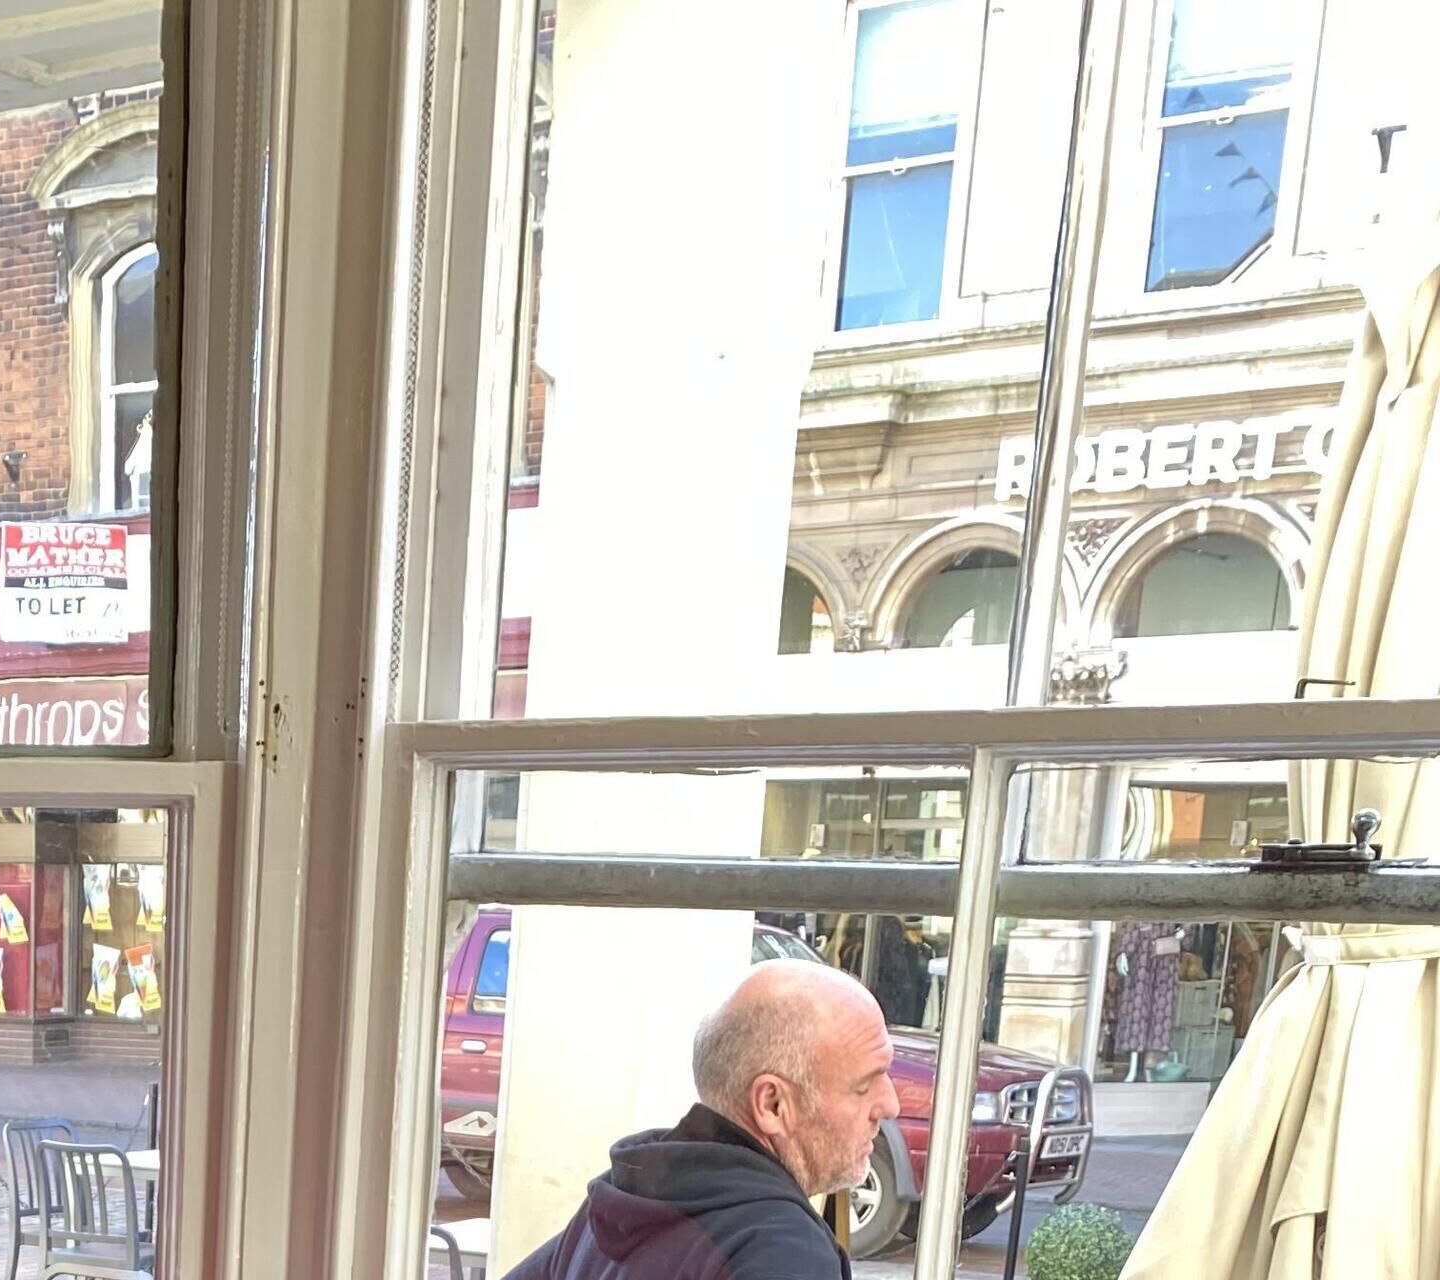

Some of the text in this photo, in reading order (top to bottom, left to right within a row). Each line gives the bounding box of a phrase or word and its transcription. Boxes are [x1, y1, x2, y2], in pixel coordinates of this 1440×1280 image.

[994, 412, 1298, 501] RBERT
[20, 525, 111, 545] BRUCE
[6, 544, 126, 568] MATHER
[7, 565, 127, 578] COMMERCIAL
[23, 576, 47, 588] ALL
[16, 597, 42, 615] TO
[49, 596, 87, 615] LET
